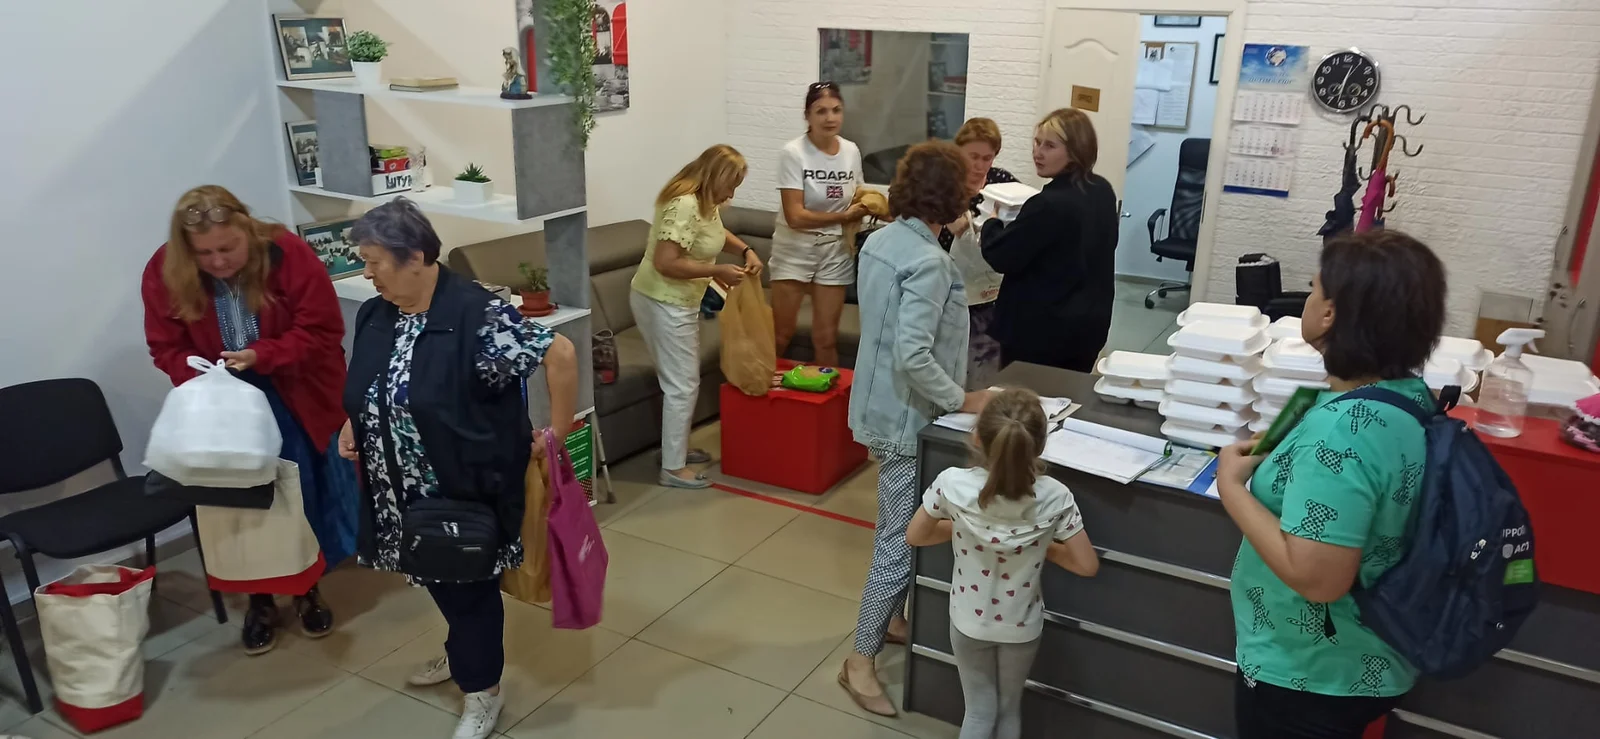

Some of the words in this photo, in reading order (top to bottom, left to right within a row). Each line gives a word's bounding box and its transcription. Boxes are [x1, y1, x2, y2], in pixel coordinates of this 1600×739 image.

[1332, 57, 1340, 66] 11
[1343, 54, 1354, 63] 12
[1322, 65, 1332, 75] 10
[1363, 65, 1373, 75] 2
[1316, 76, 1325, 85] 9
[1365, 77, 1374, 87] 3
[1318, 87, 1327, 97] 8
[1360, 88, 1368, 98] 4
[1327, 96, 1335, 105] 7
[1337, 99, 1346, 109] 6
[1350, 96, 1359, 106] 5
